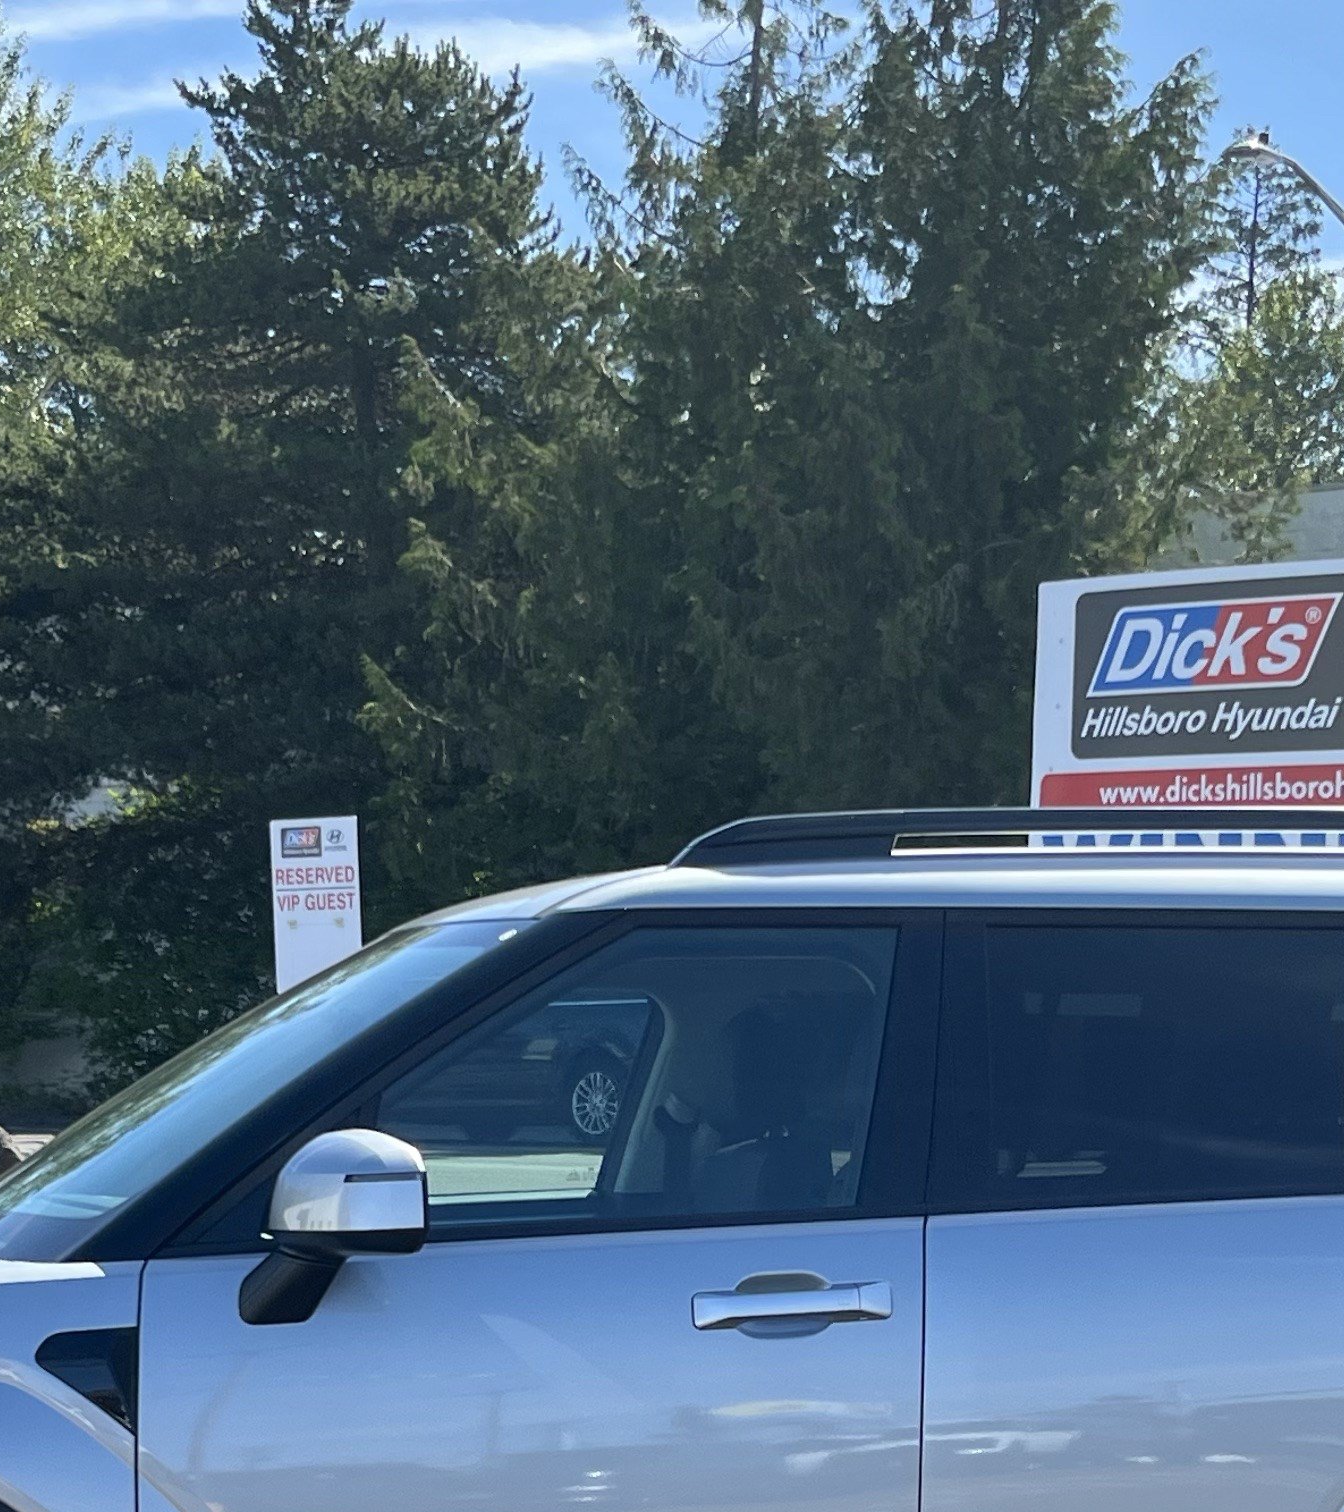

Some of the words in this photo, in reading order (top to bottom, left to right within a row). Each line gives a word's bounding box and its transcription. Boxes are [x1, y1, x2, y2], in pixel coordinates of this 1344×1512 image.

[1105, 607, 1308, 684] Dick's
[1080, 704, 1207, 738] Hillsboro
[1211, 696, 1344, 741] Hyundai
[275, 865, 355, 886] RESERVED
[277, 894, 301, 912] VIP
[305, 892, 355, 911] GUEST
